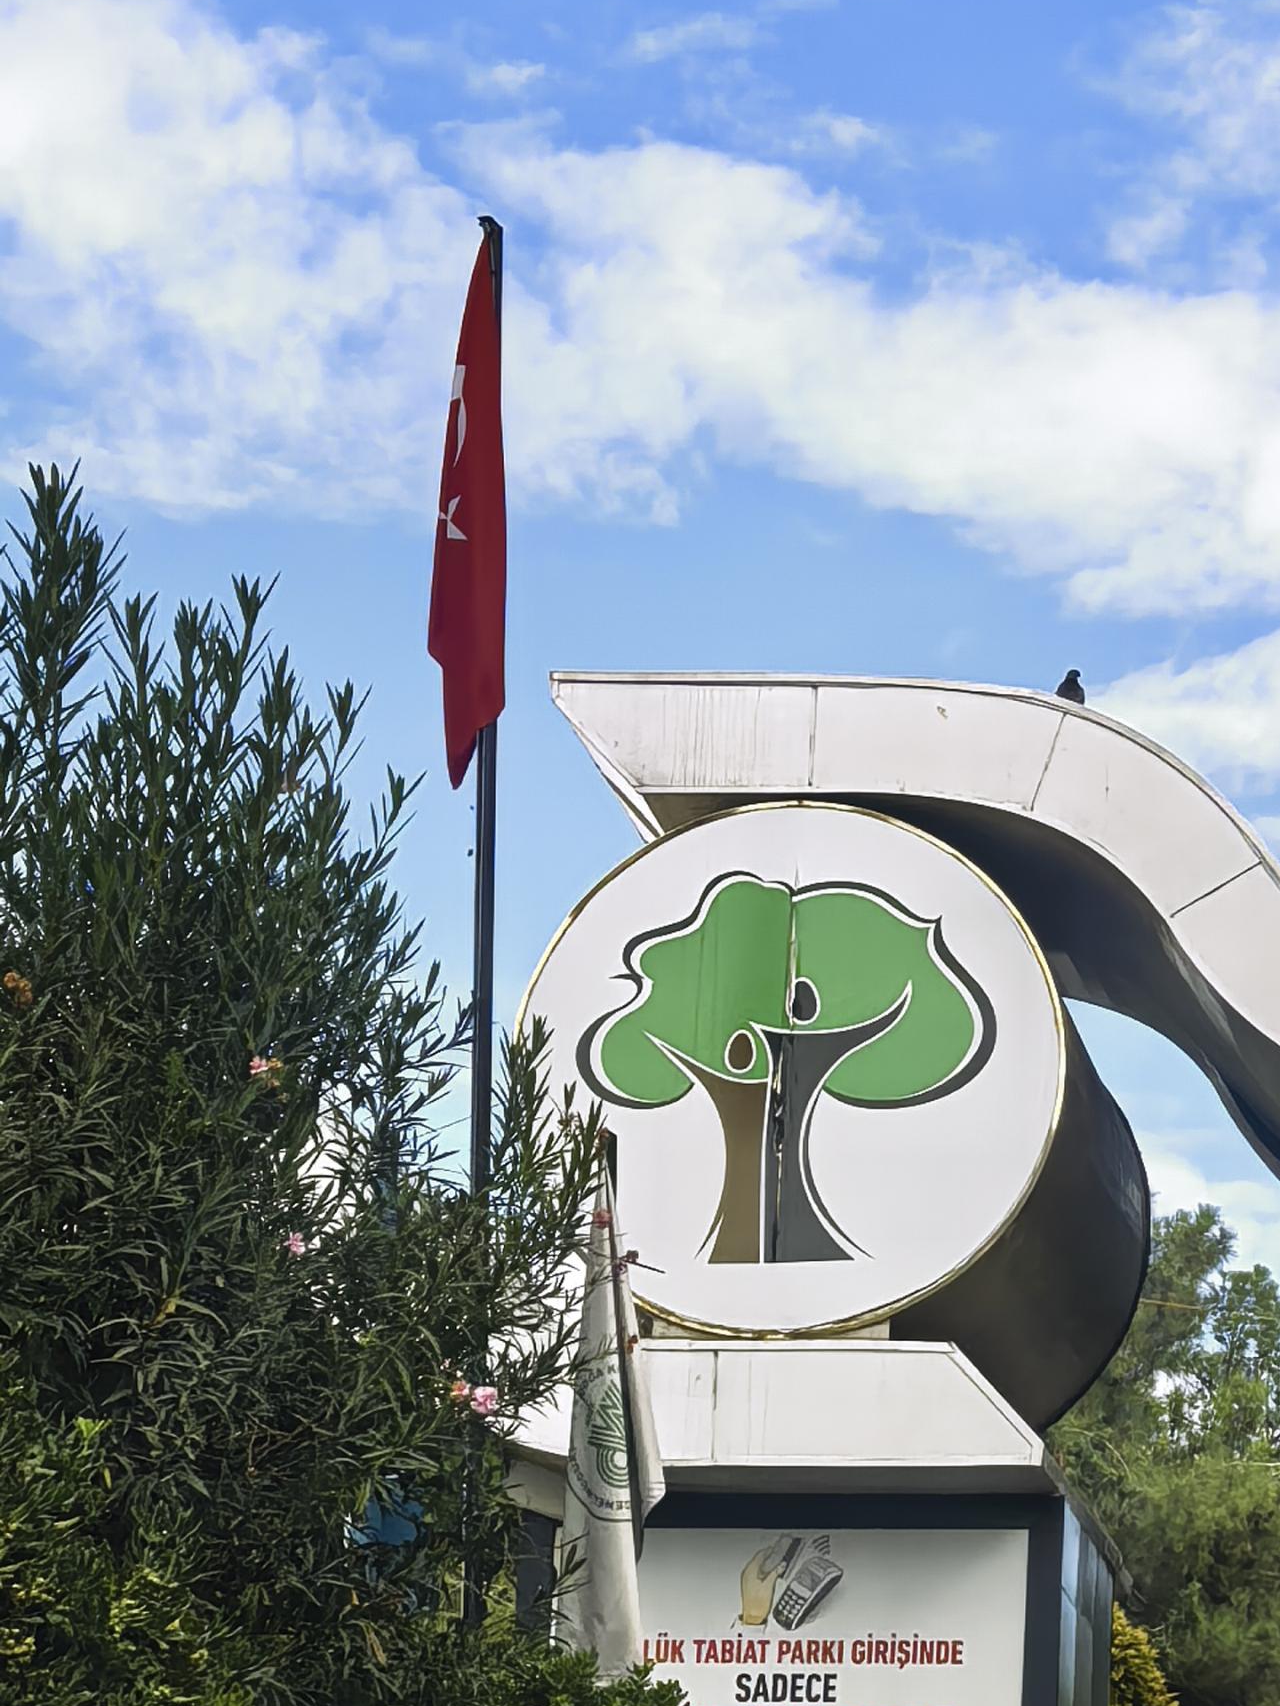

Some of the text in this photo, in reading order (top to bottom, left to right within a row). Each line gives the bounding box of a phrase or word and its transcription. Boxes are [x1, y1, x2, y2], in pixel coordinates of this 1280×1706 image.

[643, 1632, 964, 1670] LÜK TABİAT PARKI GİRİŞİNDE
[735, 1673, 837, 1703] SADECE
